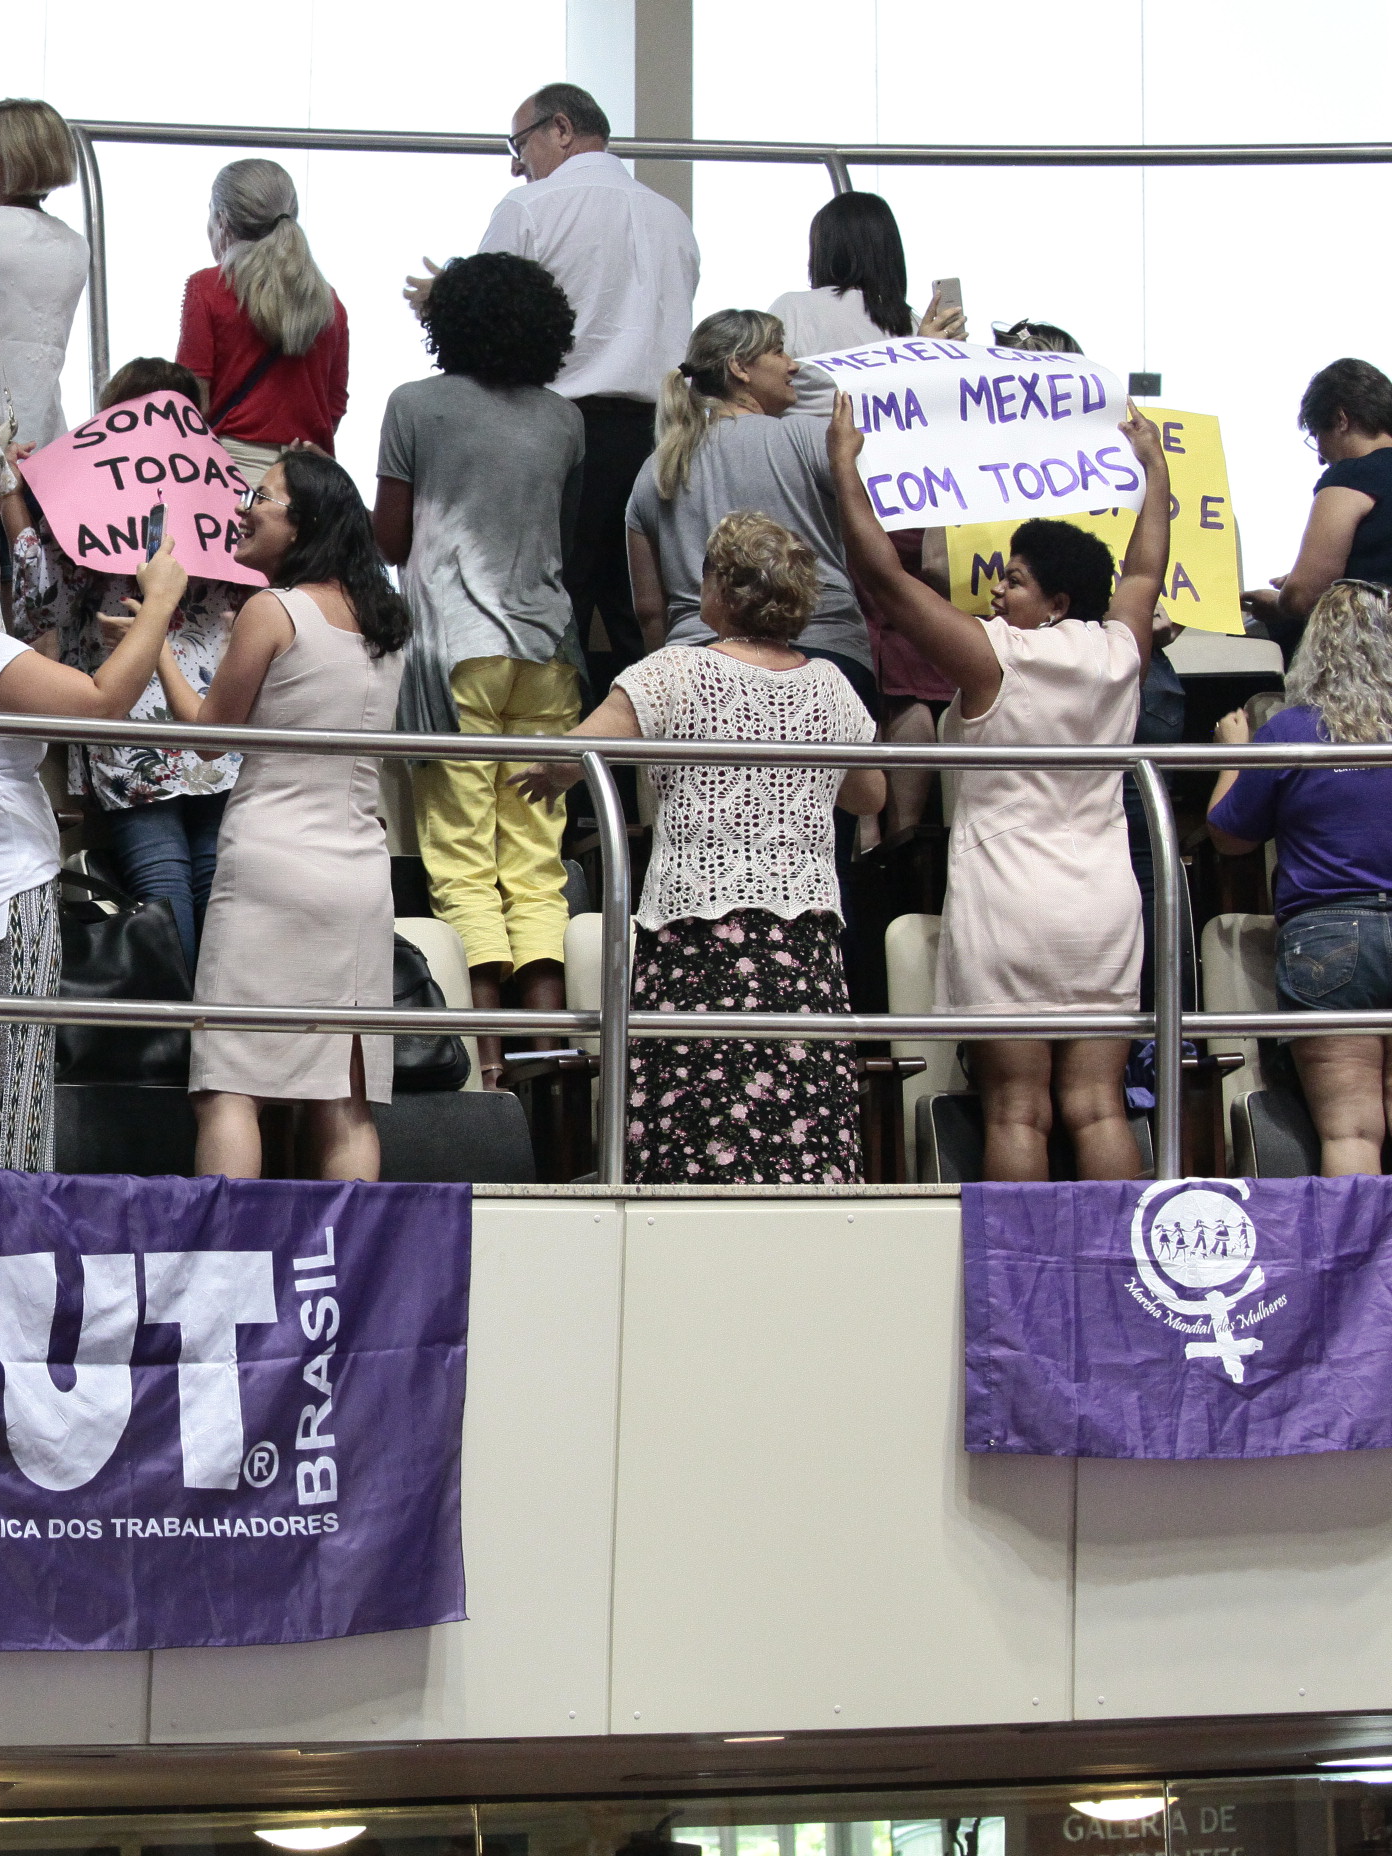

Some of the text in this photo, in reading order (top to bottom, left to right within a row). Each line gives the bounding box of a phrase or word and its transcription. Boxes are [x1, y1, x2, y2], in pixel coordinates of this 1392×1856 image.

[812, 342, 971, 371] MEXEU
[960, 373, 1106, 424] MEXEU
[73, 400, 223, 449] SOMO
[94, 453, 251, 495] TODAS
[867, 447, 1139, 517] COM TODAS
[1124, 1277, 1162, 1319] Marcha
[1164, 1310, 1213, 1335] Mundial
[1236, 1293, 1288, 1329] Mulheres
[293, 1226, 340, 1505] BRASIL
[48, 1519, 103, 1539] DOS
[111, 1512, 340, 1538] TRABALHADORES
[1062, 1805, 1238, 1842] GALERA DE
